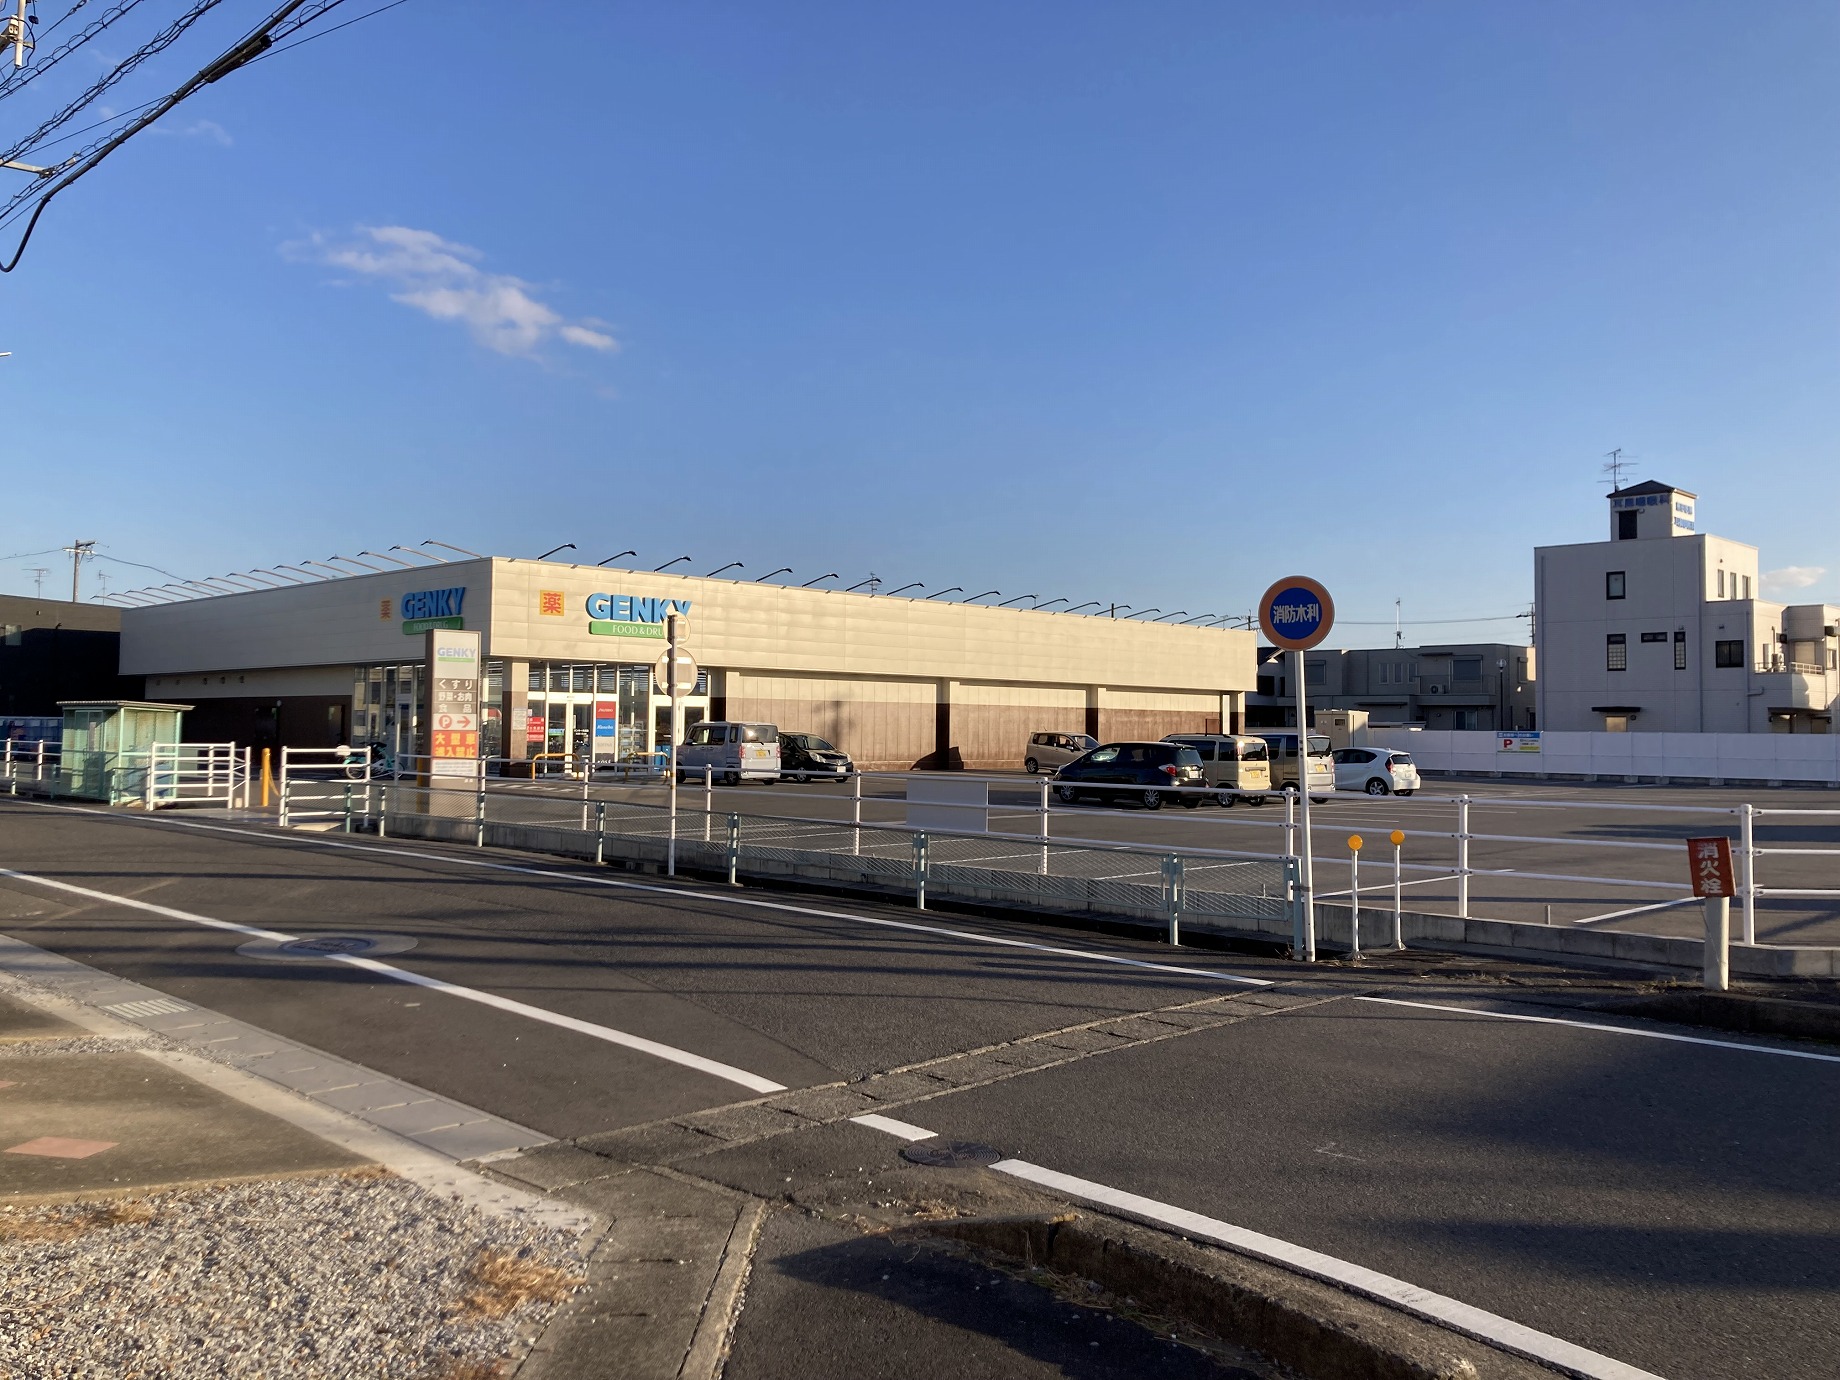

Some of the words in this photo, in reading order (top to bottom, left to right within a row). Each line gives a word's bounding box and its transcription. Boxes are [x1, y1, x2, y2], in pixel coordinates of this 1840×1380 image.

[401, 587, 467, 619] GENKY
[543, 592, 562, 614] 薬
[585, 592, 692, 624] GENKY
[1273, 603, 1320, 624] 消防水利
[437, 646, 476, 658] GENKY
[438, 679, 473, 690] くすり
[435, 732, 476, 745] 大型車
[1503, 739, 1513, 748] P
[1696, 842, 1723, 894] 消火栓
